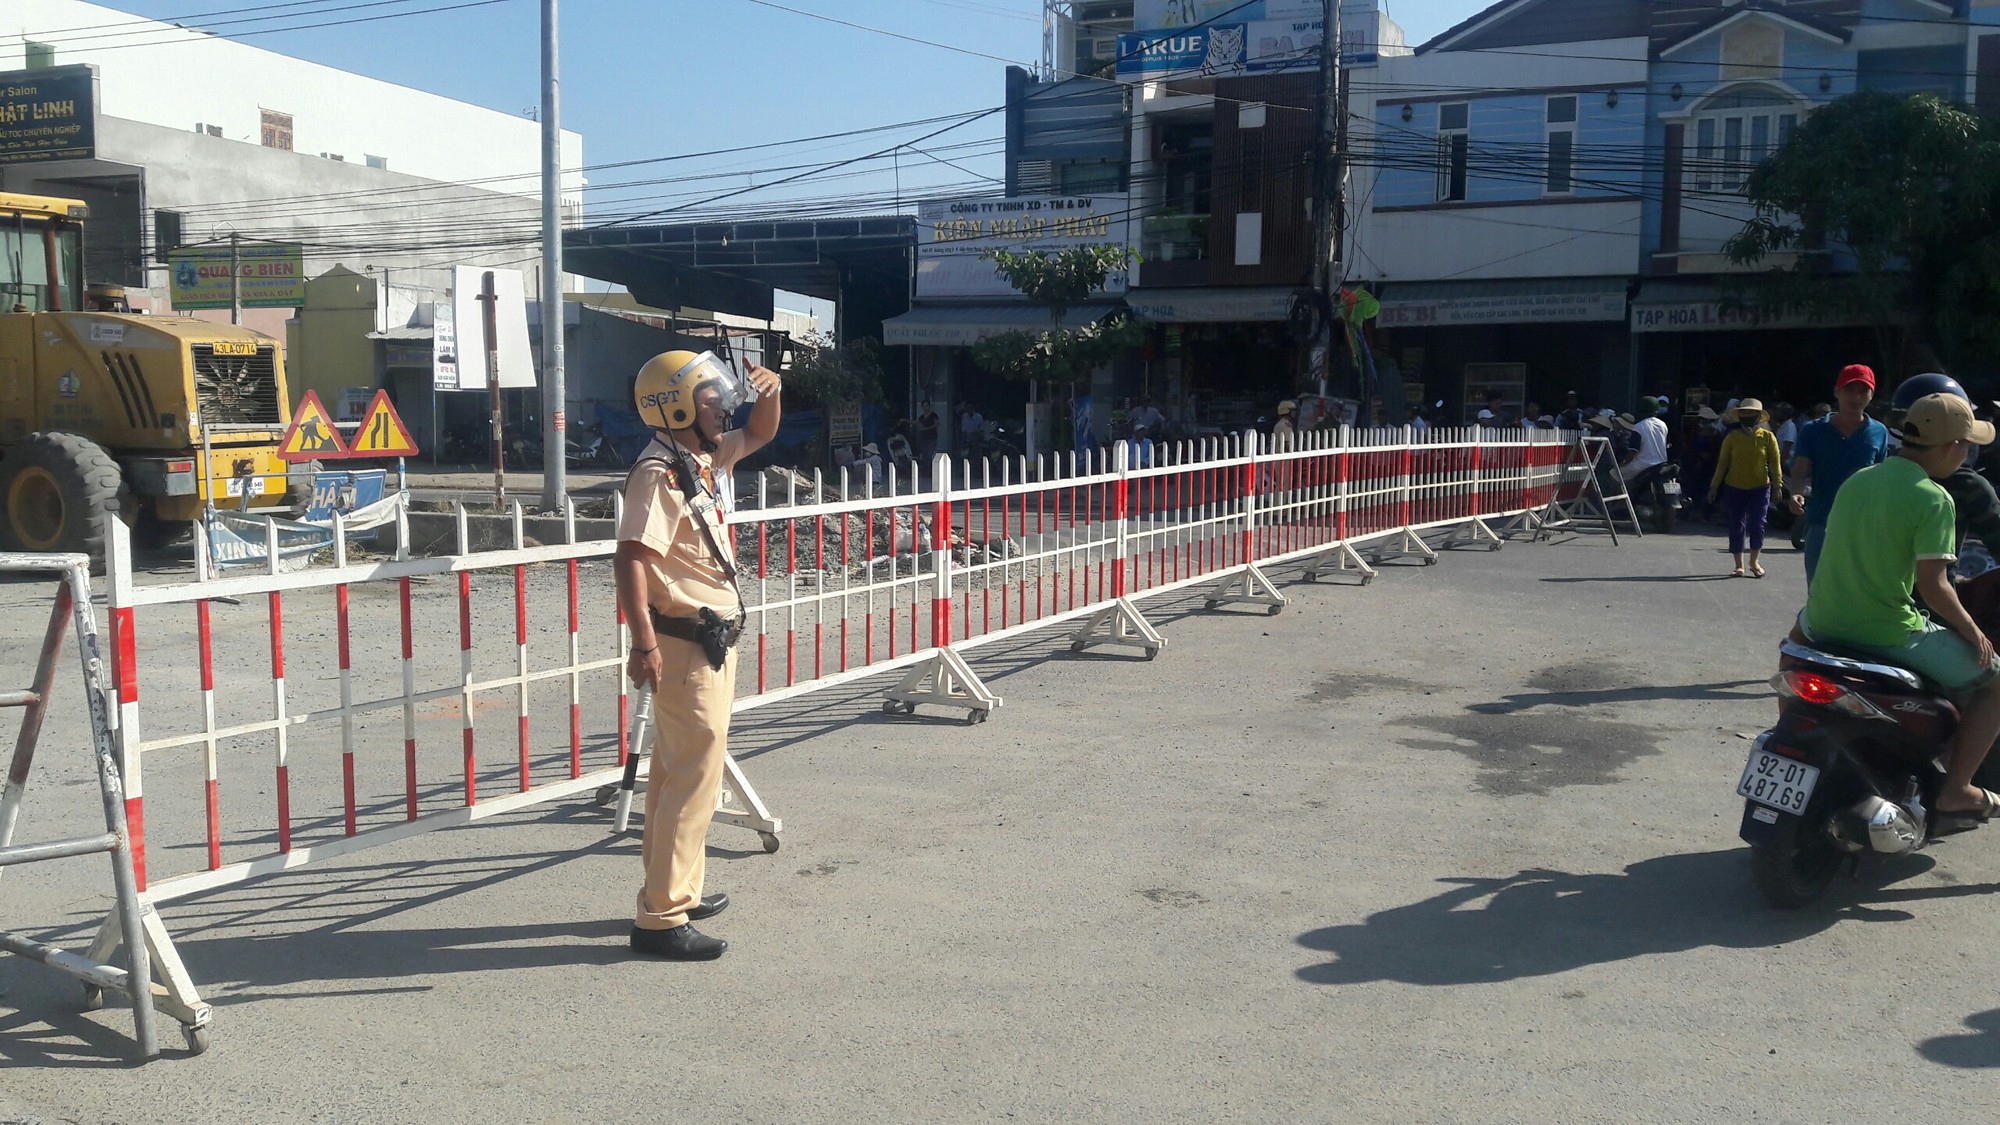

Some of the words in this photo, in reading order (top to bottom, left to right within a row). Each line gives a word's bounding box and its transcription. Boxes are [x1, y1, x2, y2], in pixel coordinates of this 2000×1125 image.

[1121, 35, 1203, 57] LARUE
[8, 86, 37, 97] Salon
[33, 99, 74, 120] LINH
[950, 201, 978, 213] CÔNG
[980, 203, 994, 212] TY
[996, 202, 1025, 212] TNHH
[1027, 200, 1041, 211] XD
[1049, 200, 1064, 210] TM
[1078, 198, 1093, 208] DV
[933, 215, 983, 242] KIÊN
[989, 213, 1047, 243] NHẬT
[1053, 207, 1111, 238] PHÁT
[198, 264, 253, 279] QUAG
[1636, 309, 1664, 328] TẠP
[640, 390, 680, 409] CSGT
[216, 541, 249, 561] XIN
[1757, 754, 1807, 787] 92-D1
[1743, 773, 1806, 811] 487.69
